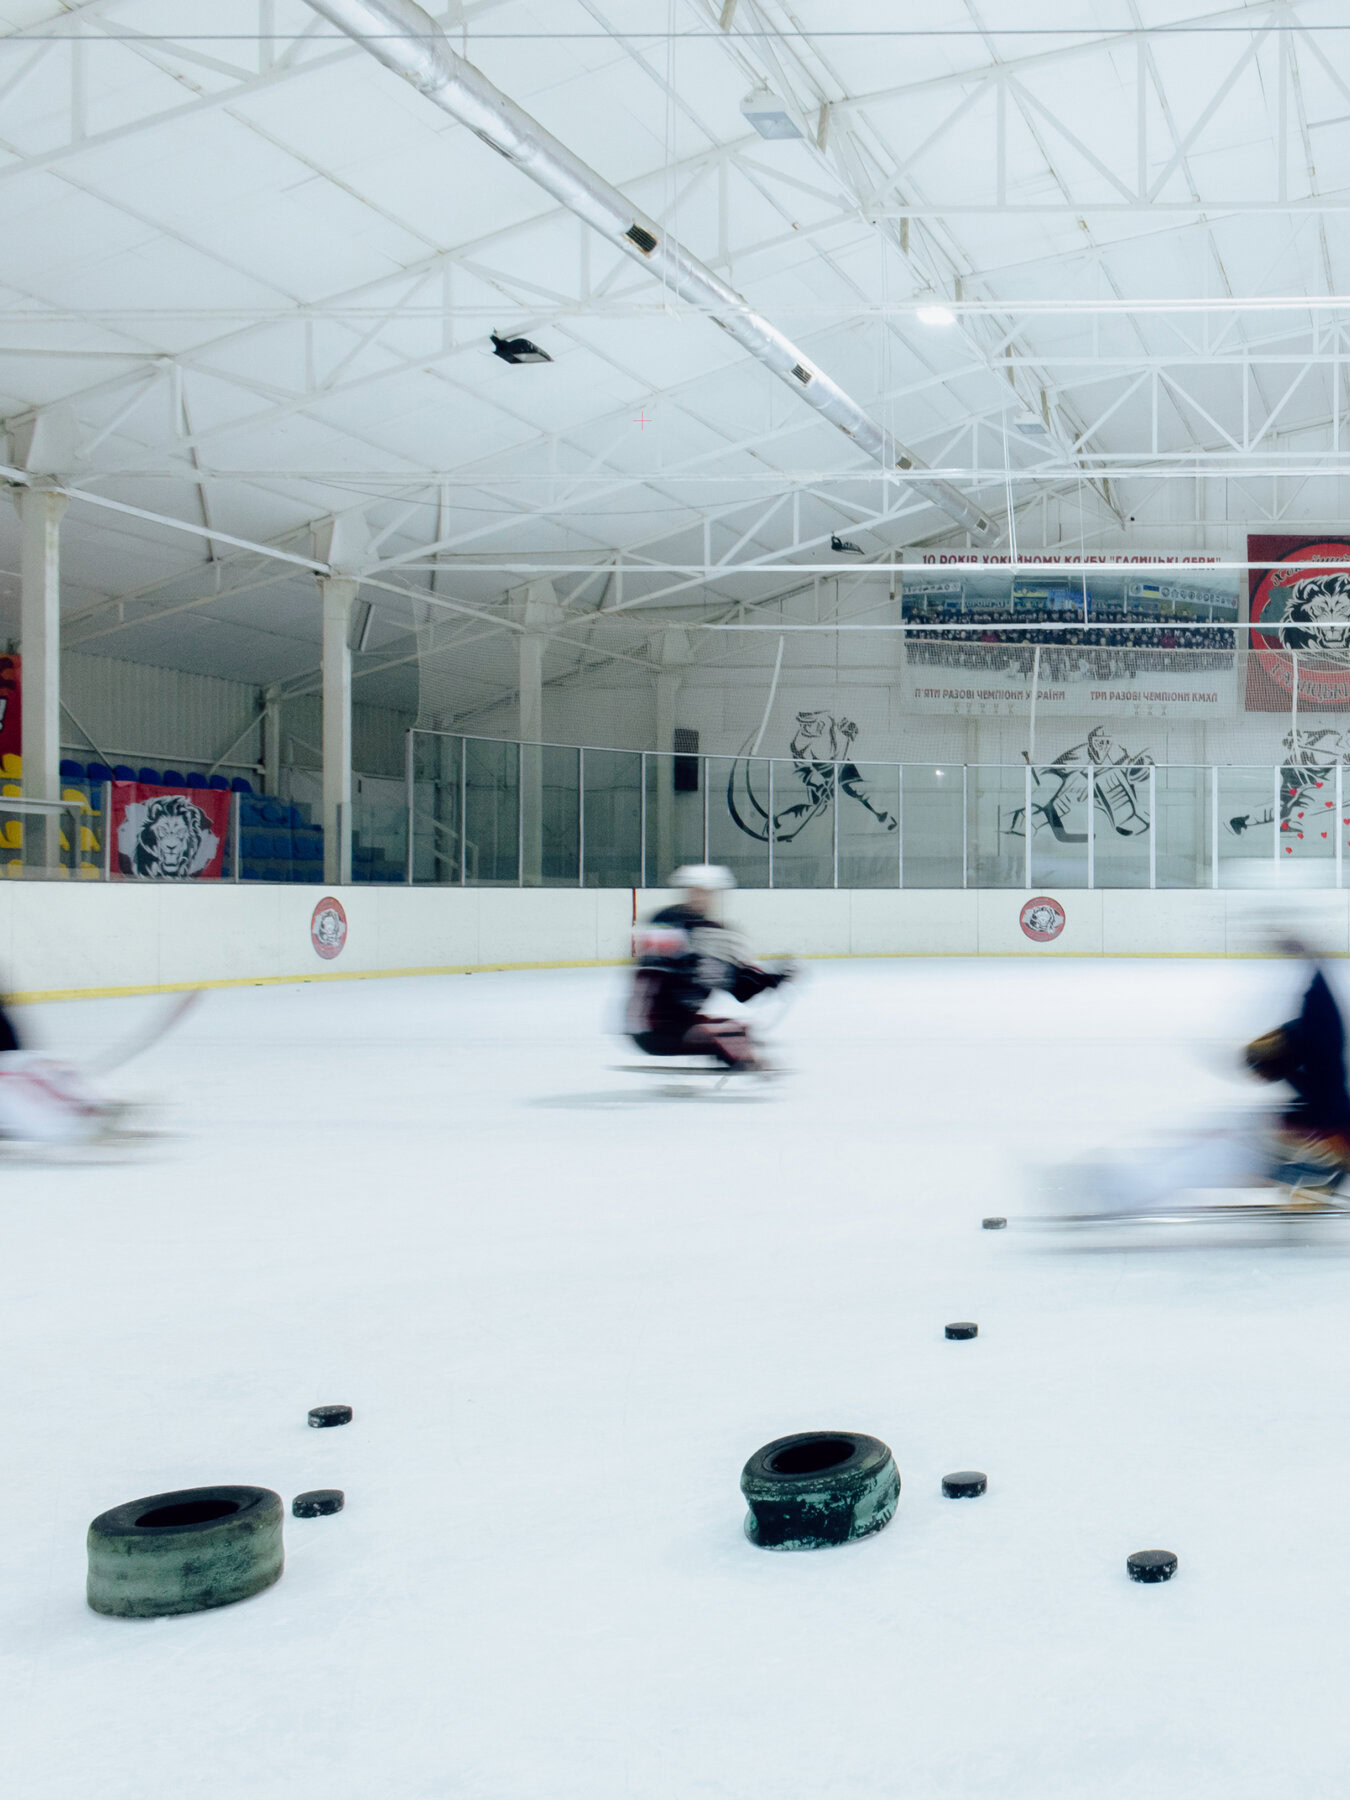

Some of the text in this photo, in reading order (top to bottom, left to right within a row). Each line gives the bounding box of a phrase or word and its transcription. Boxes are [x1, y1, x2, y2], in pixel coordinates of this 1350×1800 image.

[982, 554, 1061, 565] ХОКЙНОМУ
[942, 688, 975, 700] РАЗОВІ
[976, 688, 1024, 700] ЧЕМПІОНИ
[1025, 688, 1066, 701] УРАЇНИ
[1109, 690, 1141, 701] РАЗОВІ
[1143, 691, 1190, 702] ЧЕМПІОНИ
